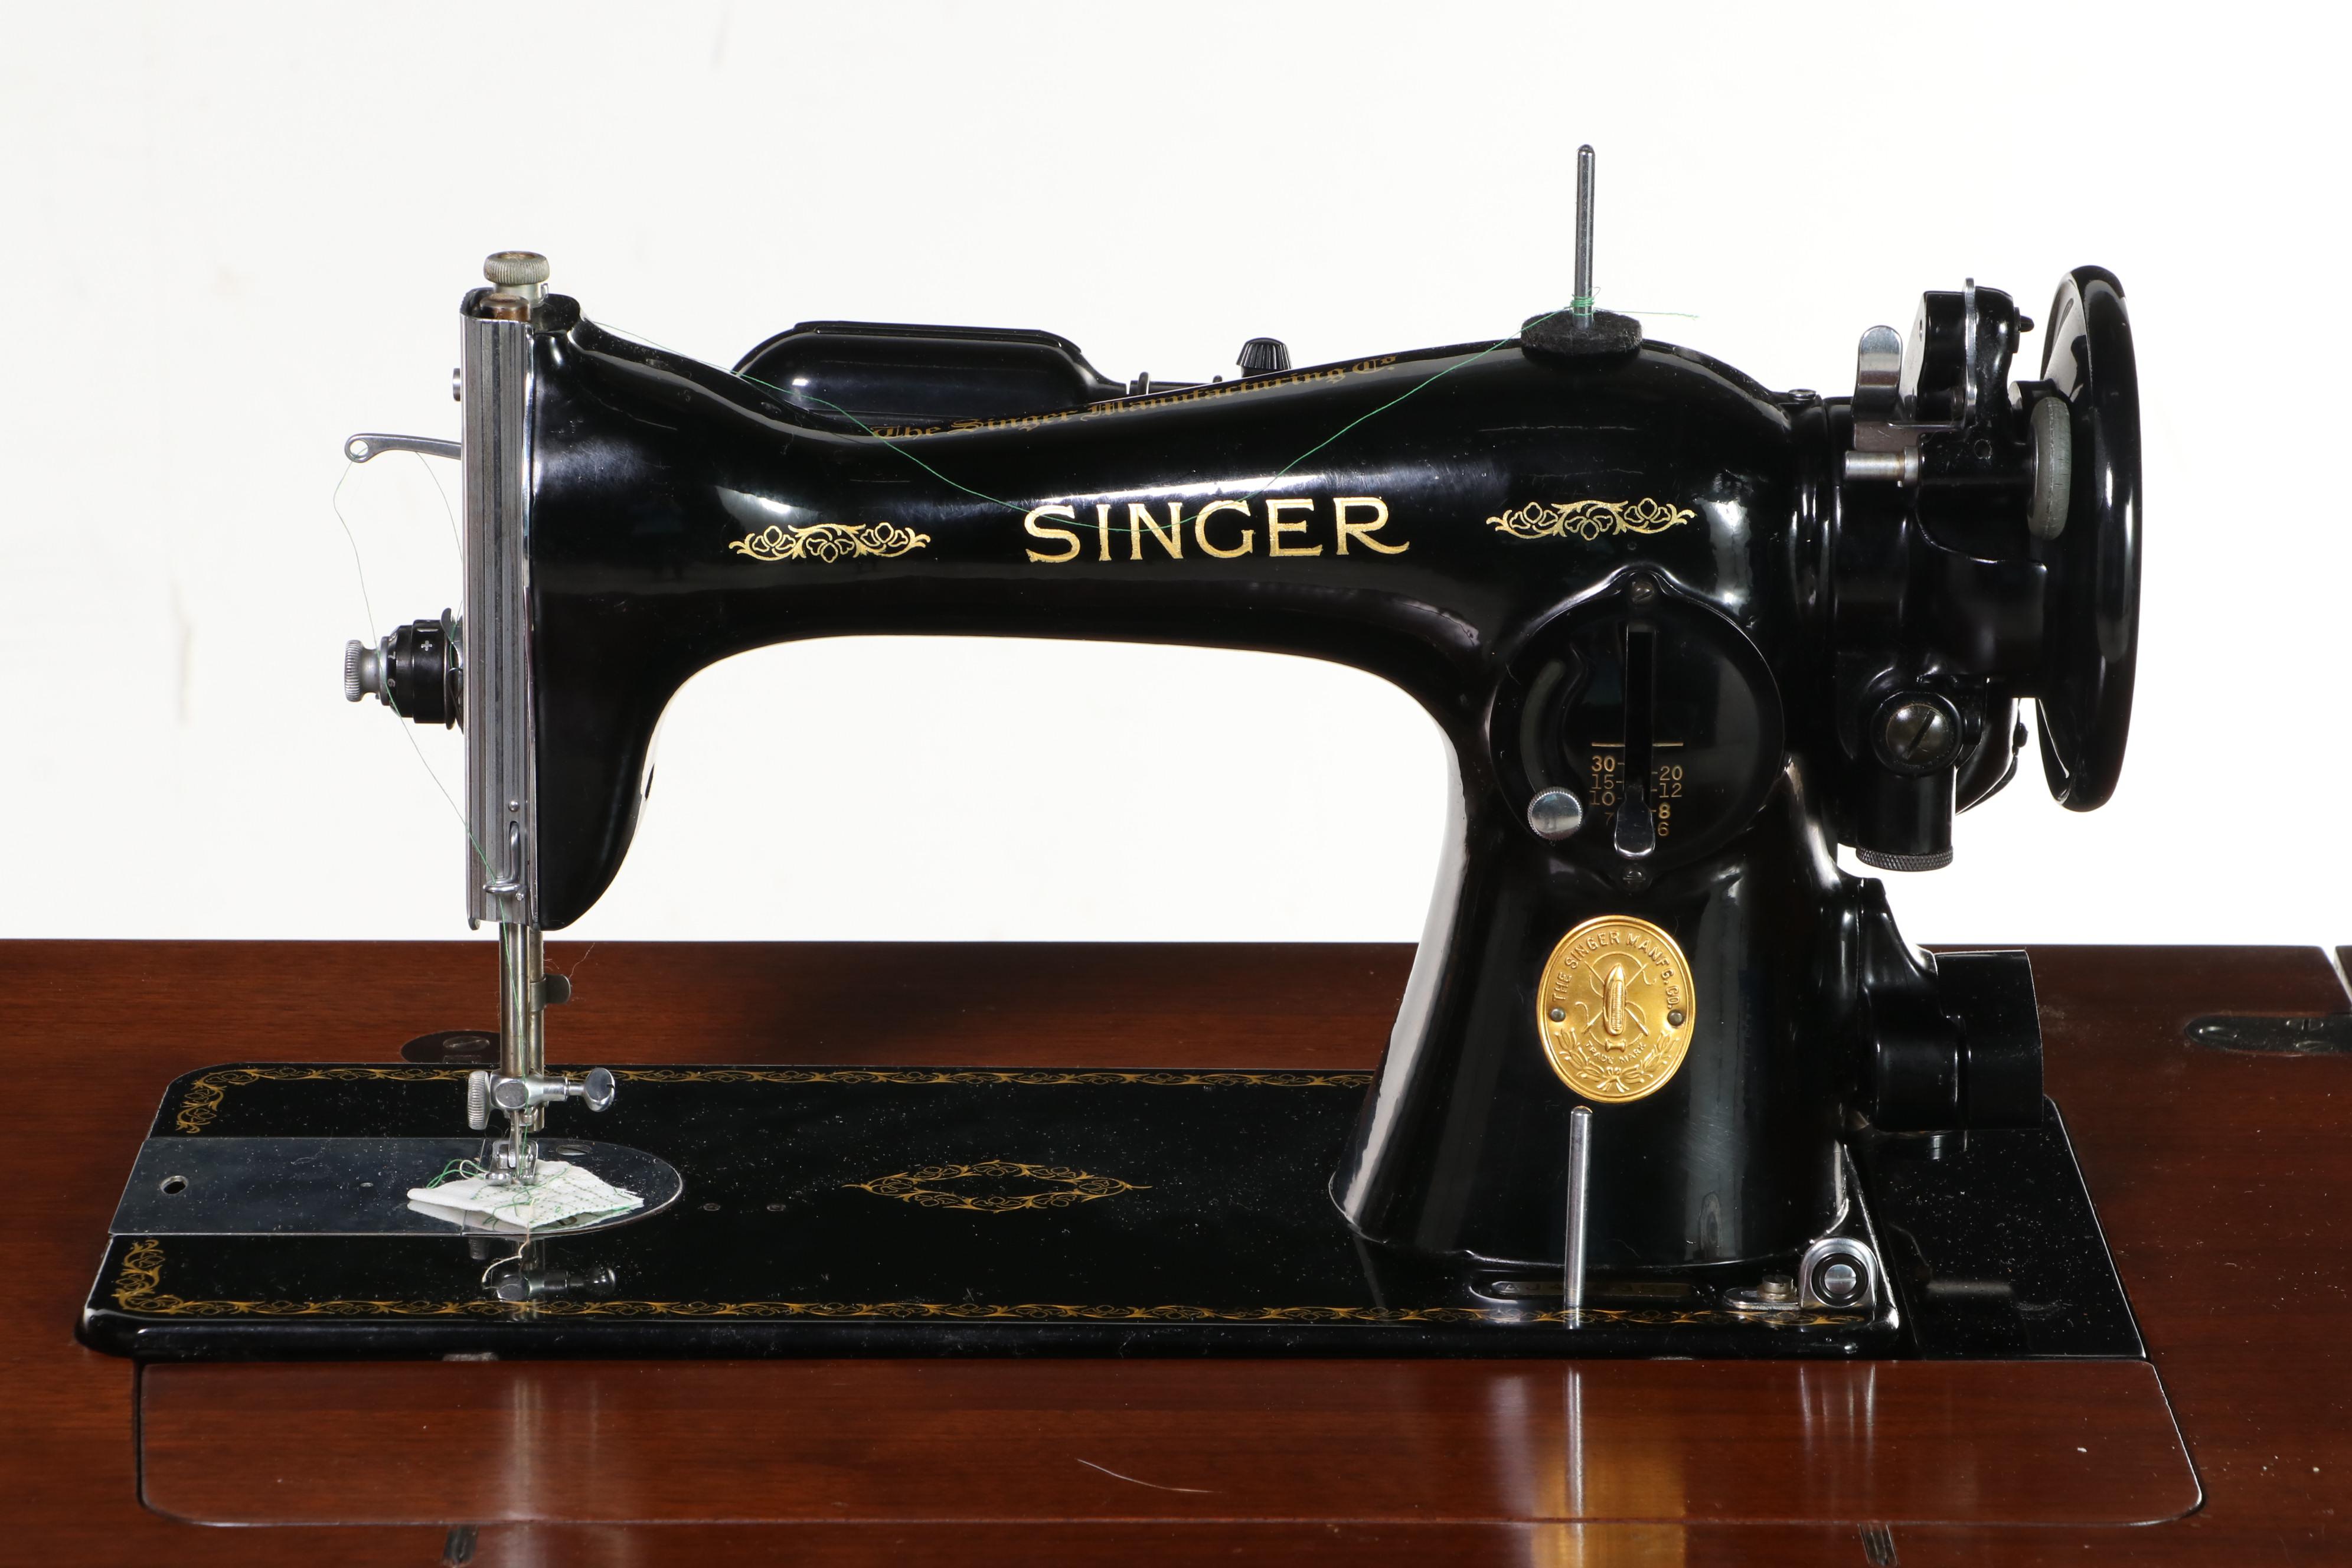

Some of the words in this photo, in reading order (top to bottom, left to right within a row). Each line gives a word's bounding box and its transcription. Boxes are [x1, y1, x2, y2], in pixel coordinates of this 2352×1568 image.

[870, 424, 942, 440] The
[947, 408, 1078, 435] Singer
[1080, 365, 1346, 422] Manufacturing
[1024, 496, 1410, 563] SINGER
[1592, 756, 1615, 772] 30
[1660, 766, 1683, 780] 20
[1592, 775, 1614, 789] 15
[1590, 791, 1615, 806] 10
[1660, 783, 1682, 798] 12
[1658, 802, 1671, 819] 8
[1658, 822, 1670, 836] 6
[1551, 971, 1572, 1002] THE
[1565, 931, 1620, 969] SINGER
[1585, 1040, 1614, 1064] TRADE
[1619, 1041, 1647, 1063] MARK
